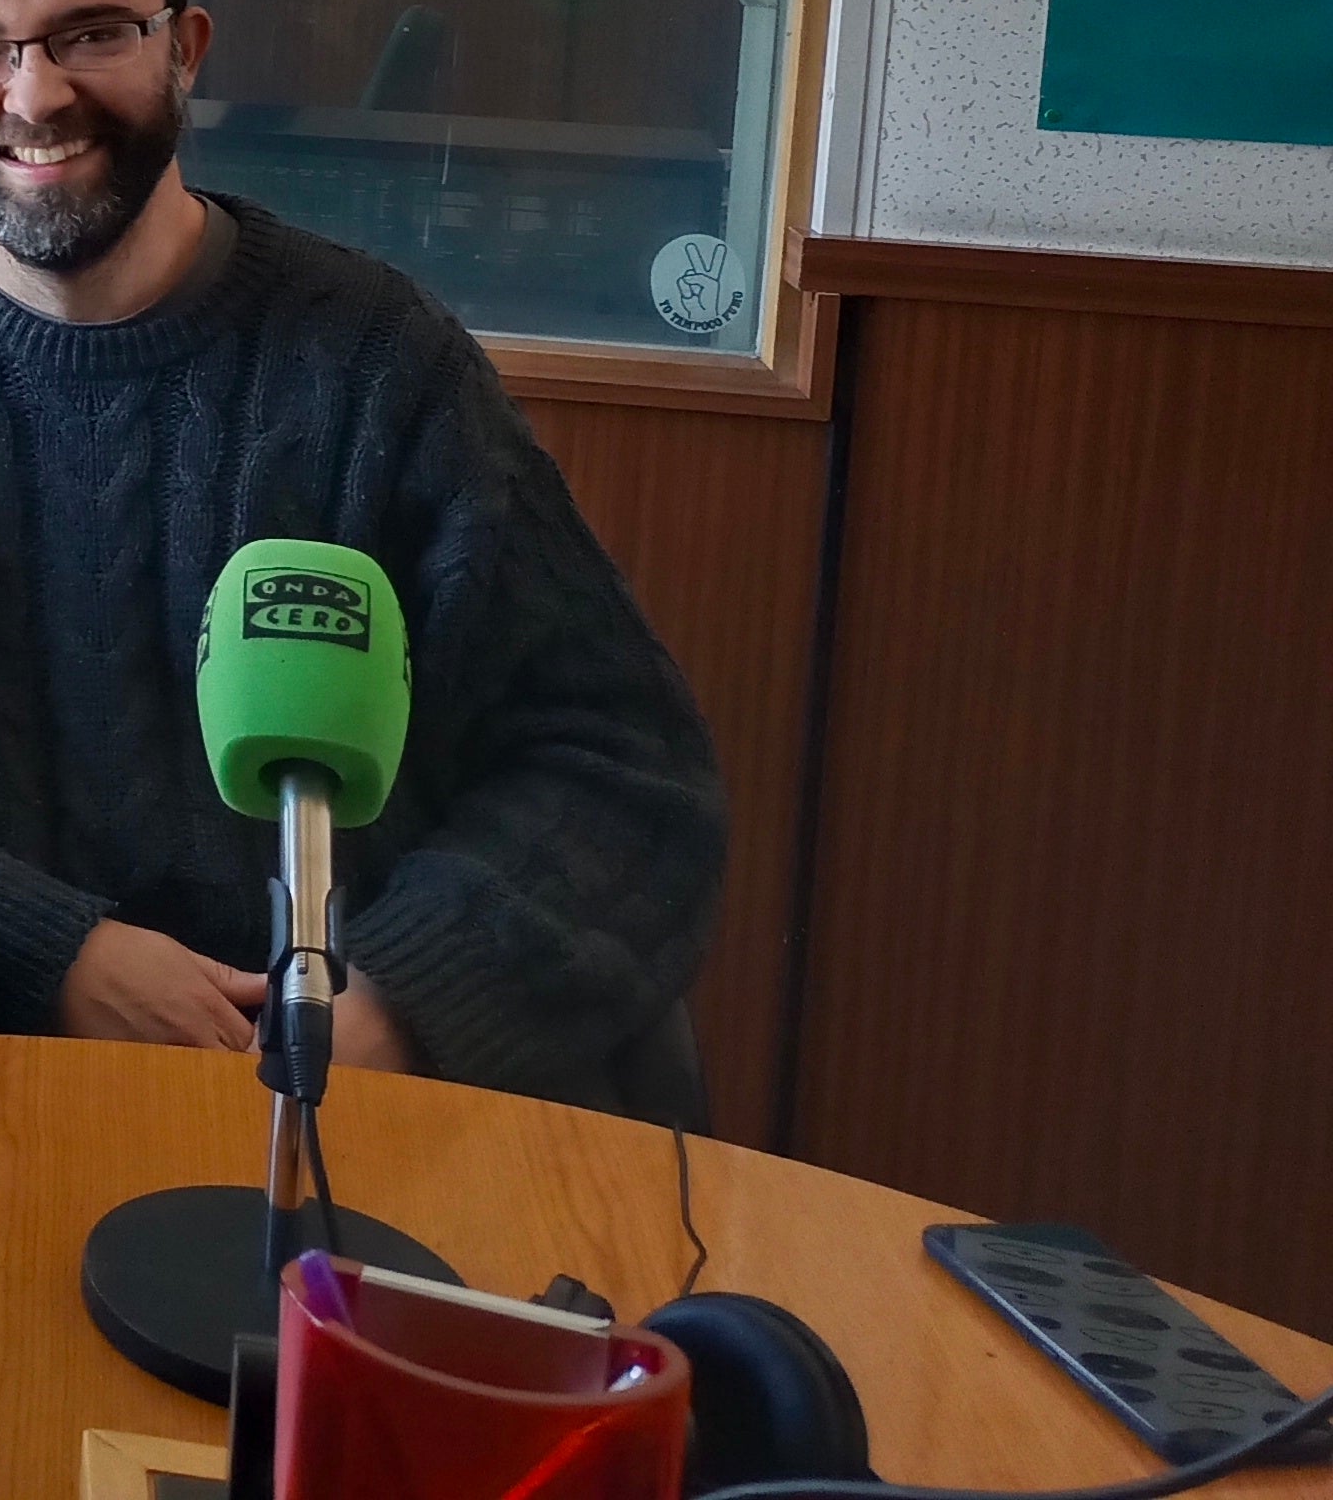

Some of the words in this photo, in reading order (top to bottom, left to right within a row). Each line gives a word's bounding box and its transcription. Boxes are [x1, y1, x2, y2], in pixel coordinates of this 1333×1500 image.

[659, 299, 673, 313] YO
[670, 312, 723, 331] TAMPOCO
[722, 291, 744, 322] FUMO
[262, 581, 351, 602] ONDA
[266, 607, 351, 631] CERO
